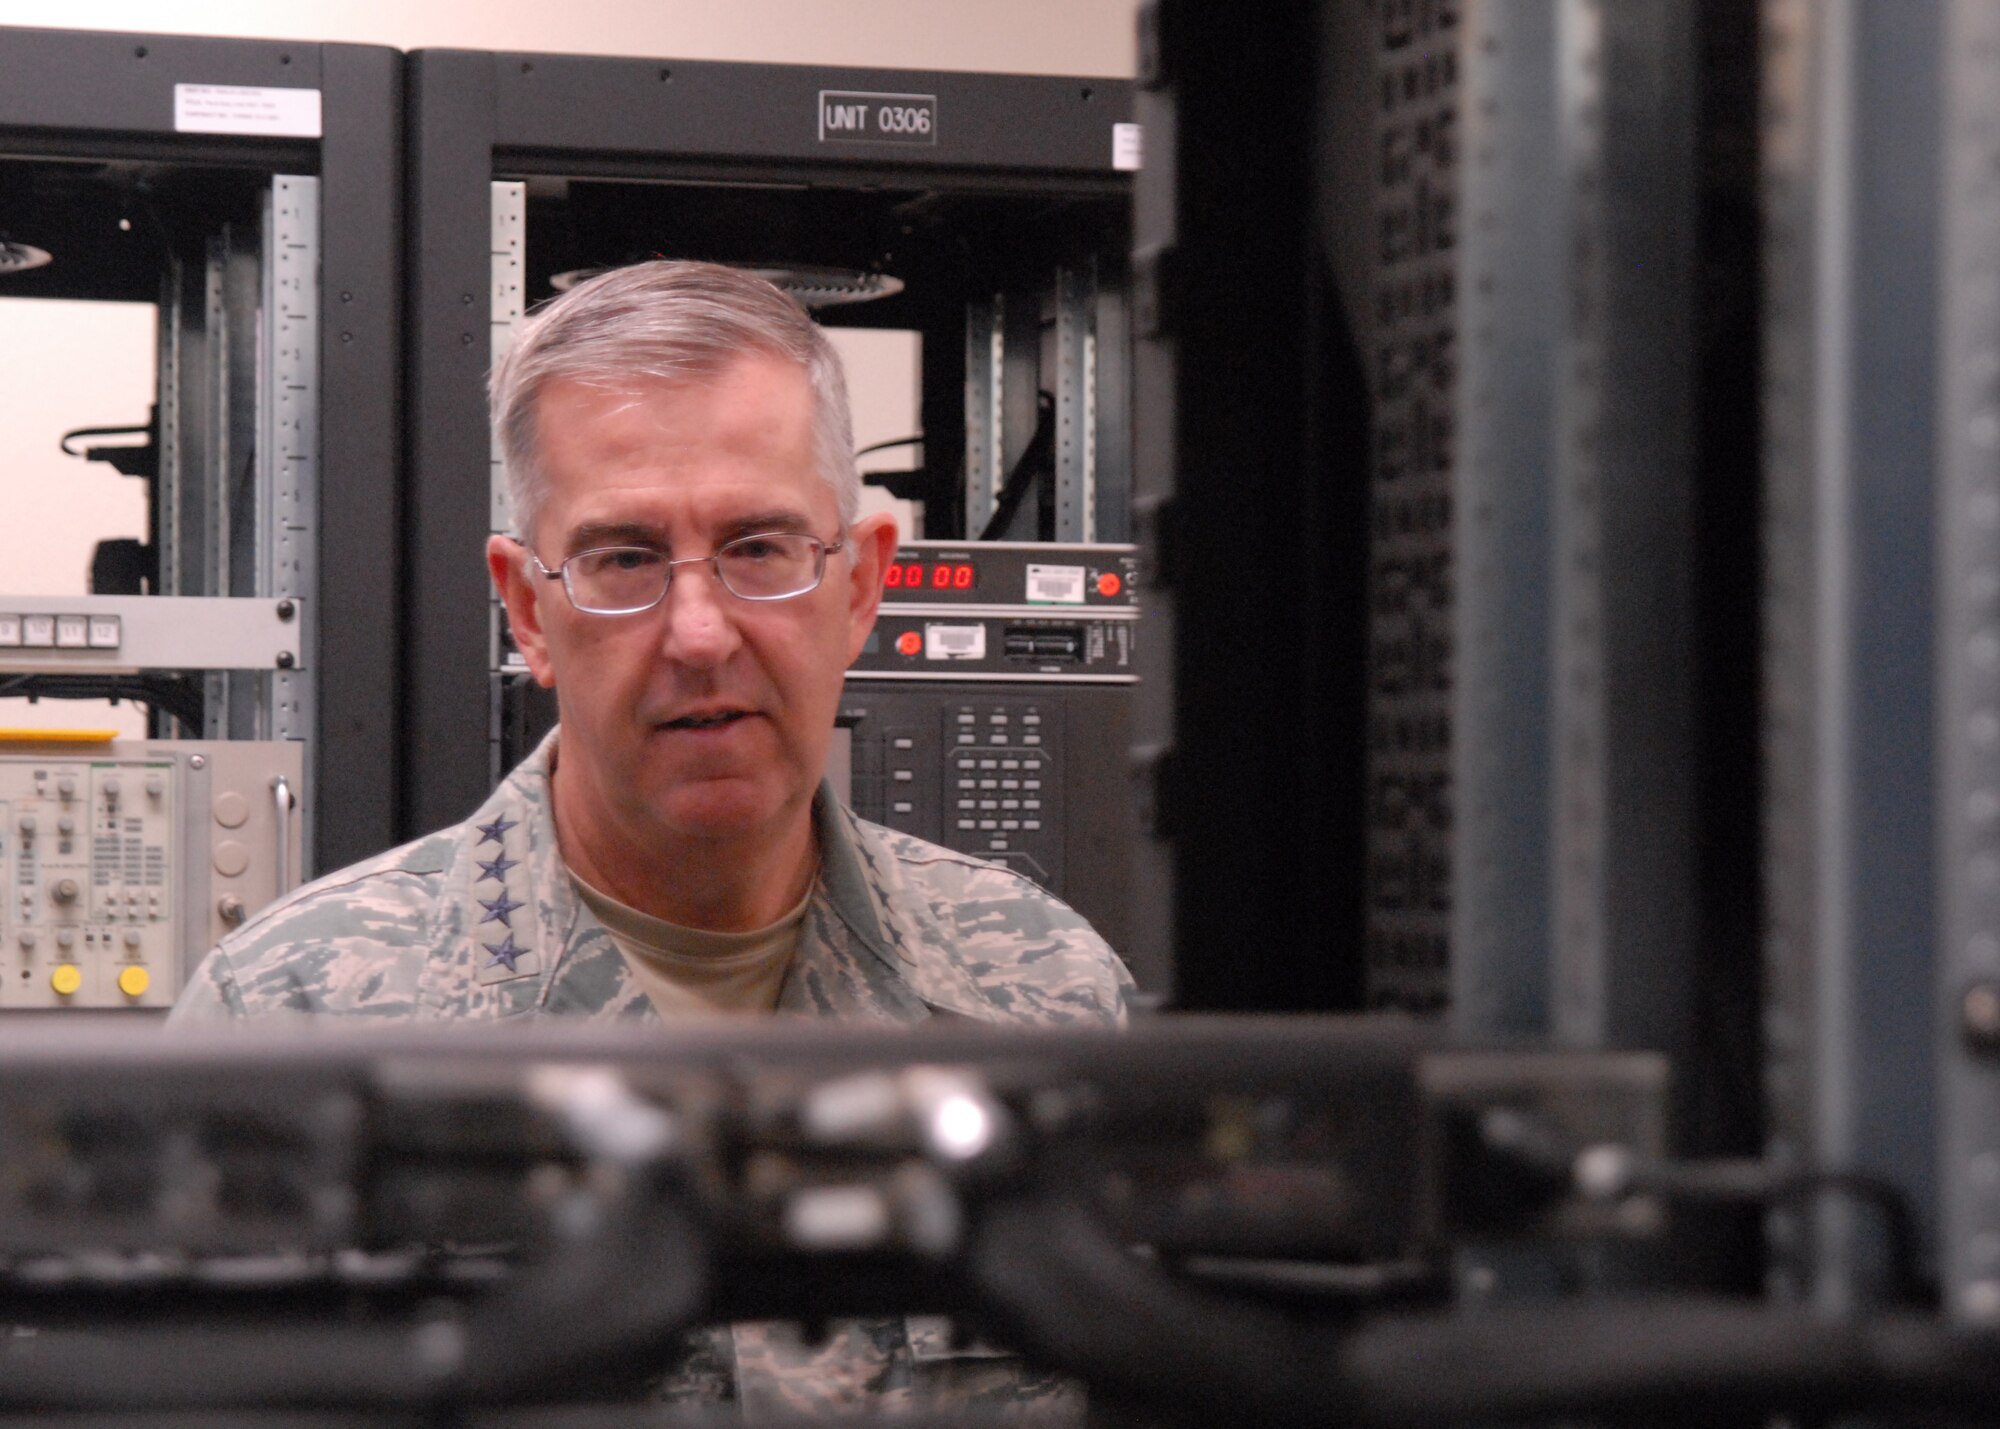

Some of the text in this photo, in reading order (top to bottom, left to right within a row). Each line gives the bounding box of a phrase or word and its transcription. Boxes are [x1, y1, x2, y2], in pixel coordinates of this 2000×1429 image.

[825, 104, 931, 134] UNIT 0306
[885, 565, 973, 588] 00 00
[33, 621, 47, 634] 10
[65, 625, 77, 637] 11
[97, 625, 111, 638] 12
